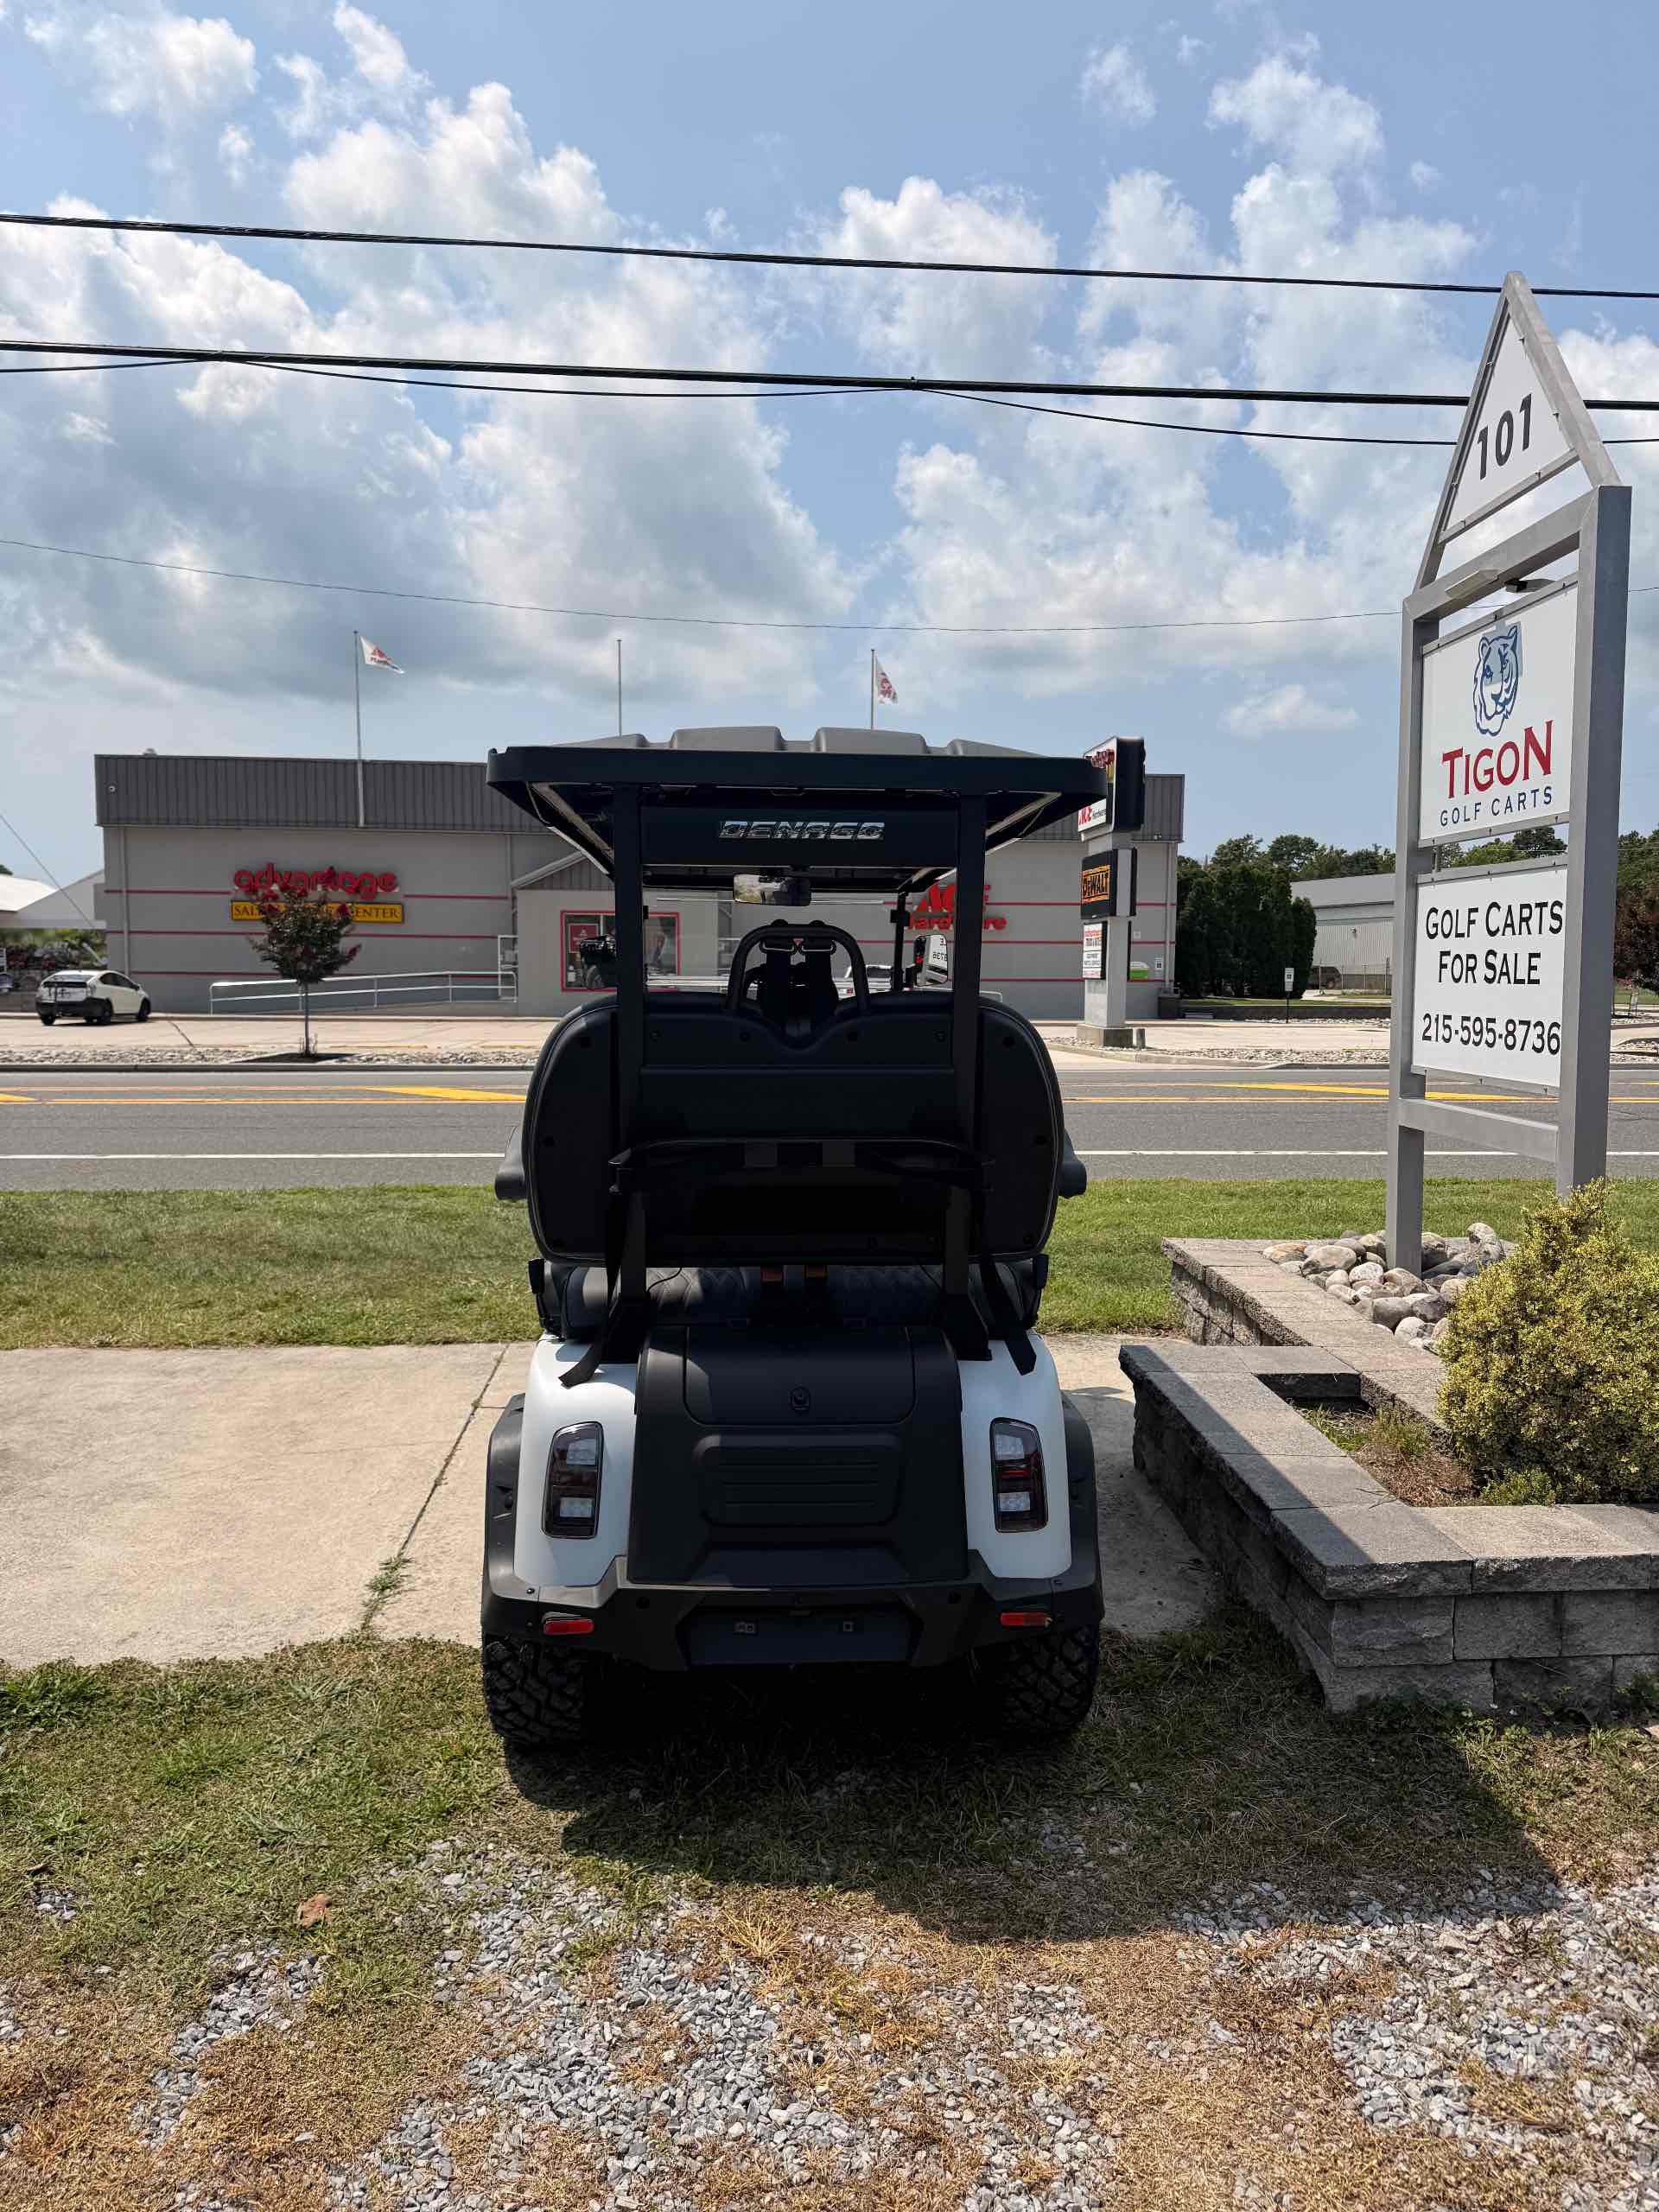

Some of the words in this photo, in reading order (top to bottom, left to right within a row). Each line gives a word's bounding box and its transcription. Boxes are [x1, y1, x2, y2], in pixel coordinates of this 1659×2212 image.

[1477, 393, 1533, 480] 101
[1441, 719, 1554, 798] TIGON
[1440, 801, 1482, 827] GOLF
[1491, 785, 1553, 817] CARTS
[719, 820, 886, 840] DENAGO
[353, 905, 401, 918] ENTER
[1425, 906, 1479, 940] GOLF
[1485, 899, 1564, 938] CARTS
[1438, 950, 1478, 984] FOR
[1483, 949, 1541, 985] SALE
[1421, 1013, 1562, 1056] 215-595-8736
